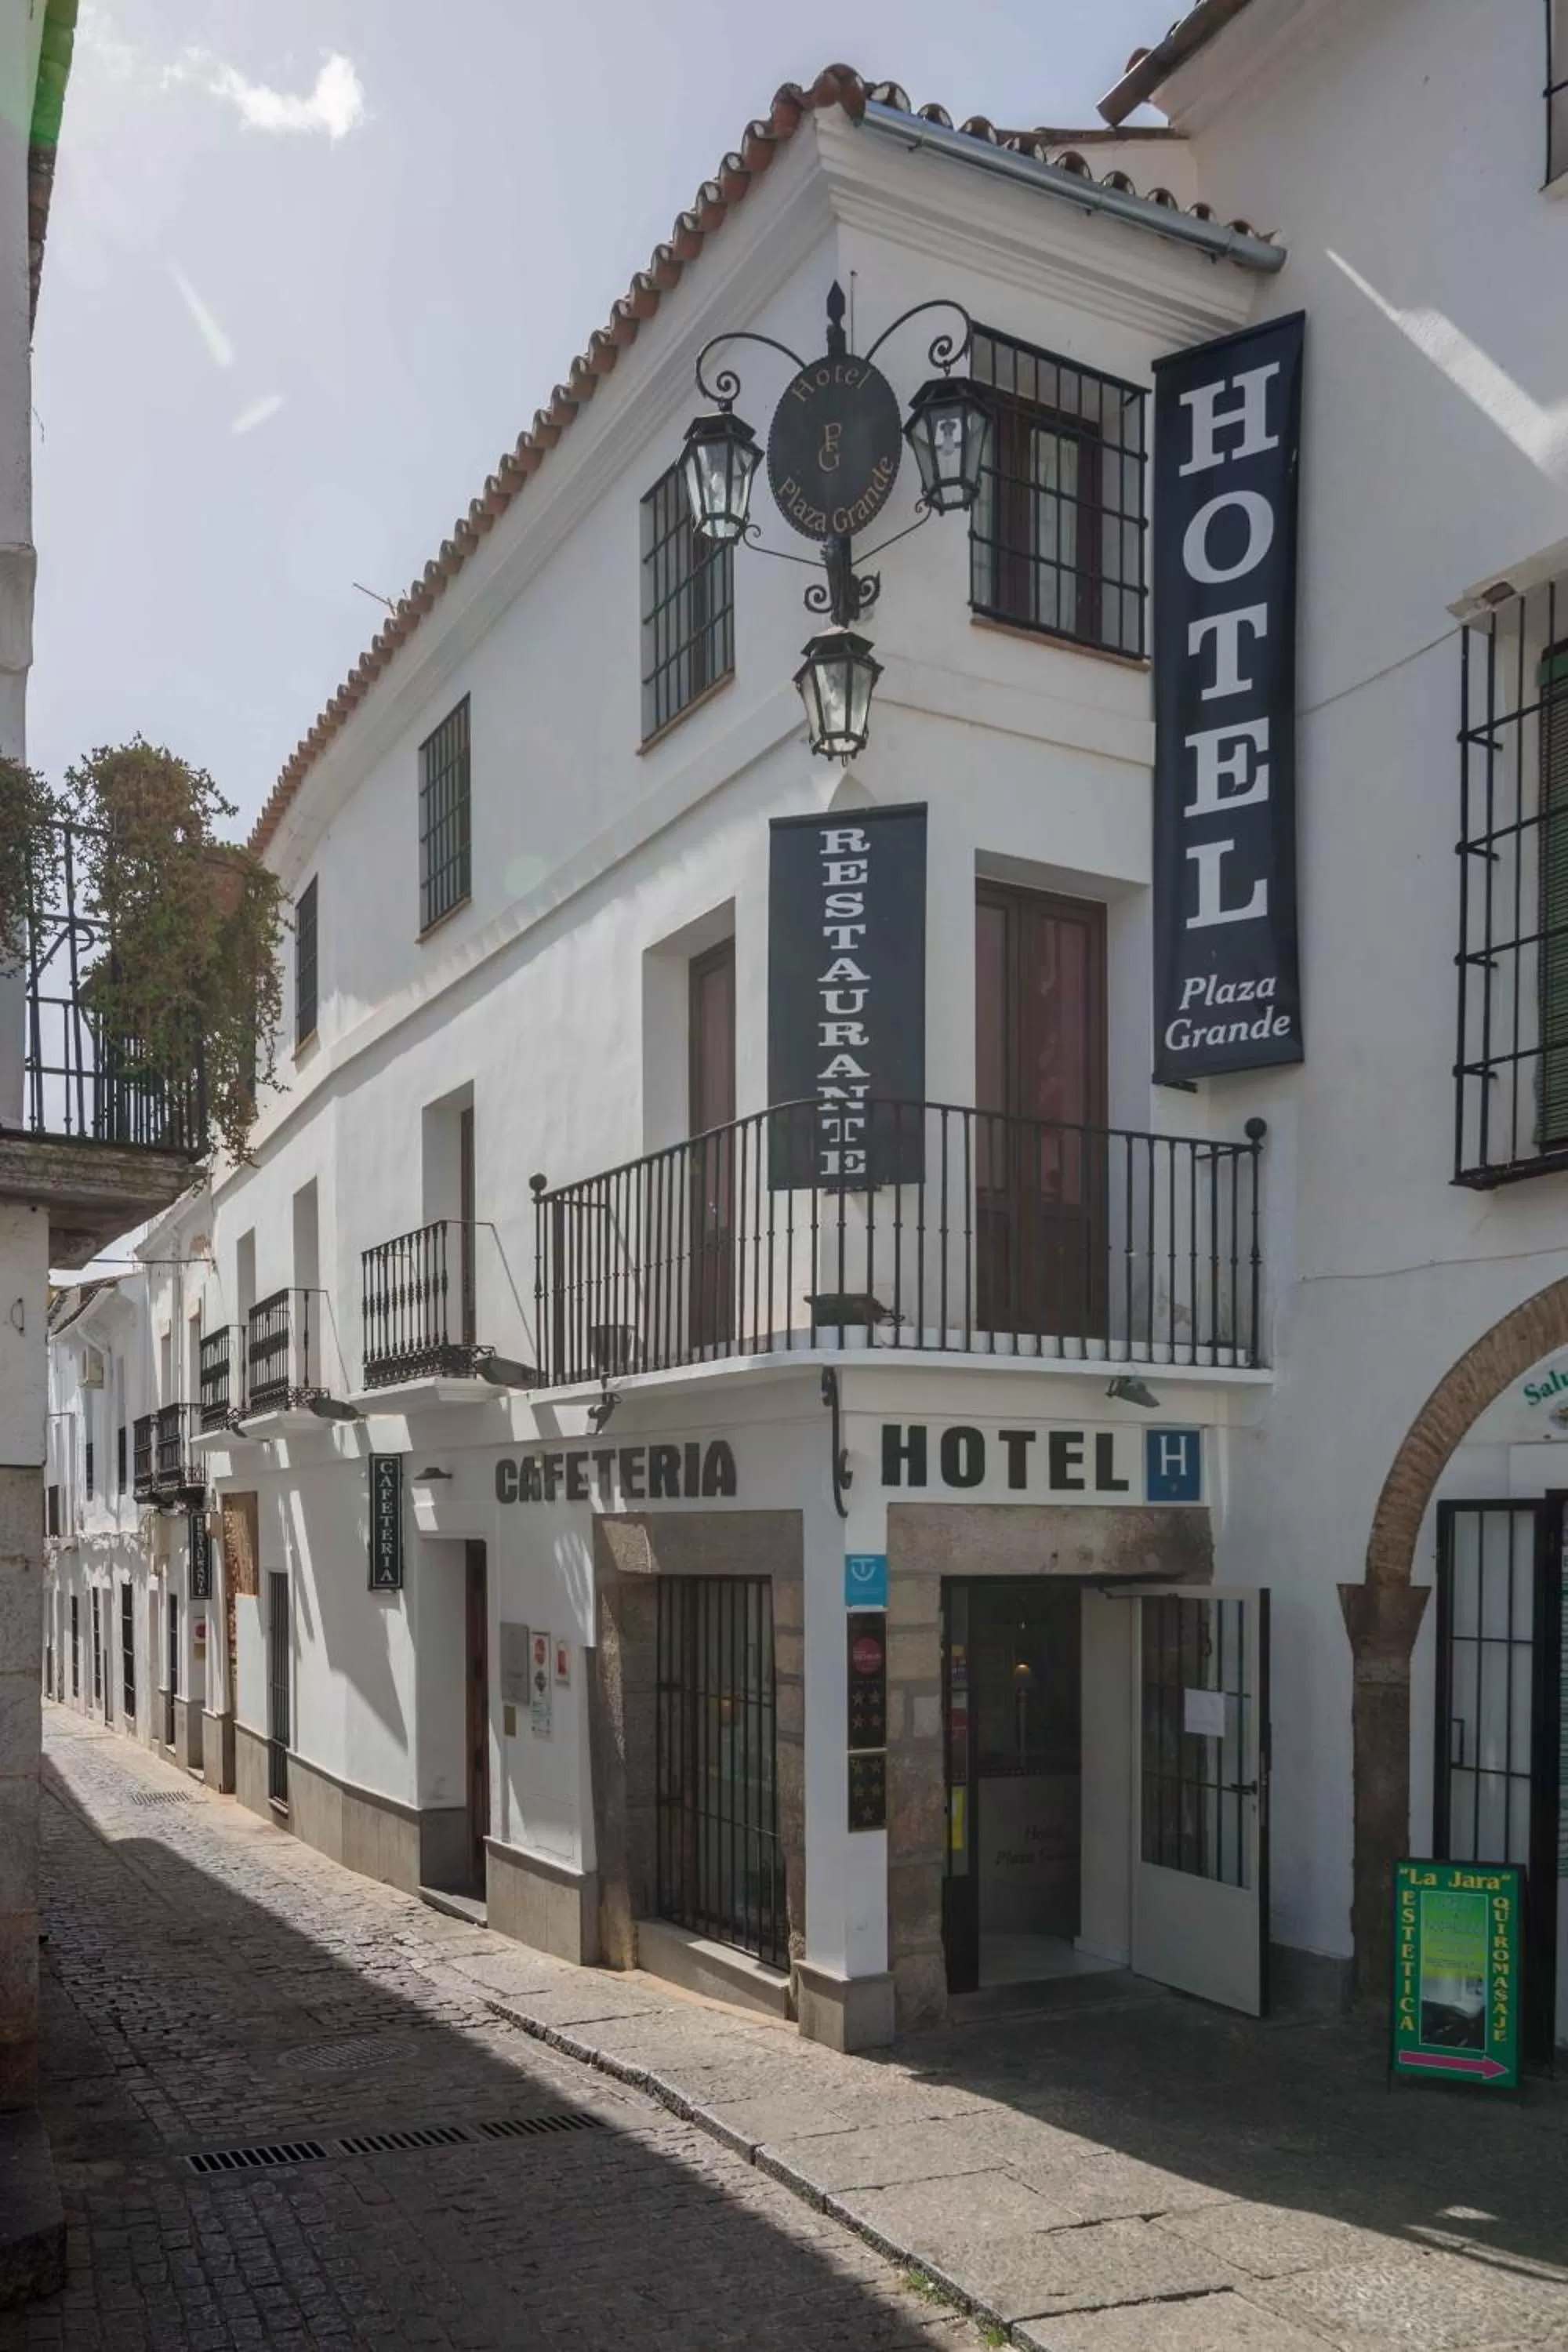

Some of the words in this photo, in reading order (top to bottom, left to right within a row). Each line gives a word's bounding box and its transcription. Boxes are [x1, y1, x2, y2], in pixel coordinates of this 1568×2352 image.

[791, 364, 874, 402] Hotel
[778, 477, 826, 532] Plaza
[832, 455, 895, 534] Grande
[1179, 361, 1280, 928] HOTEL
[817, 827, 872, 1175] RESTAURANTE
[1163, 1005, 1291, 1052] Grande
[1178, 974, 1278, 1011] Plaza
[495, 1439, 737, 1504] CAFETERIA
[881, 1424, 1130, 1491] HOTEL
[1160, 1435, 1189, 1477] H
[379, 1461, 394, 1582] CAFETERIA
[1399, 1890, 1416, 2031] ESTETICA
[1492, 1896, 1511, 2042] QUIROMASAJE
